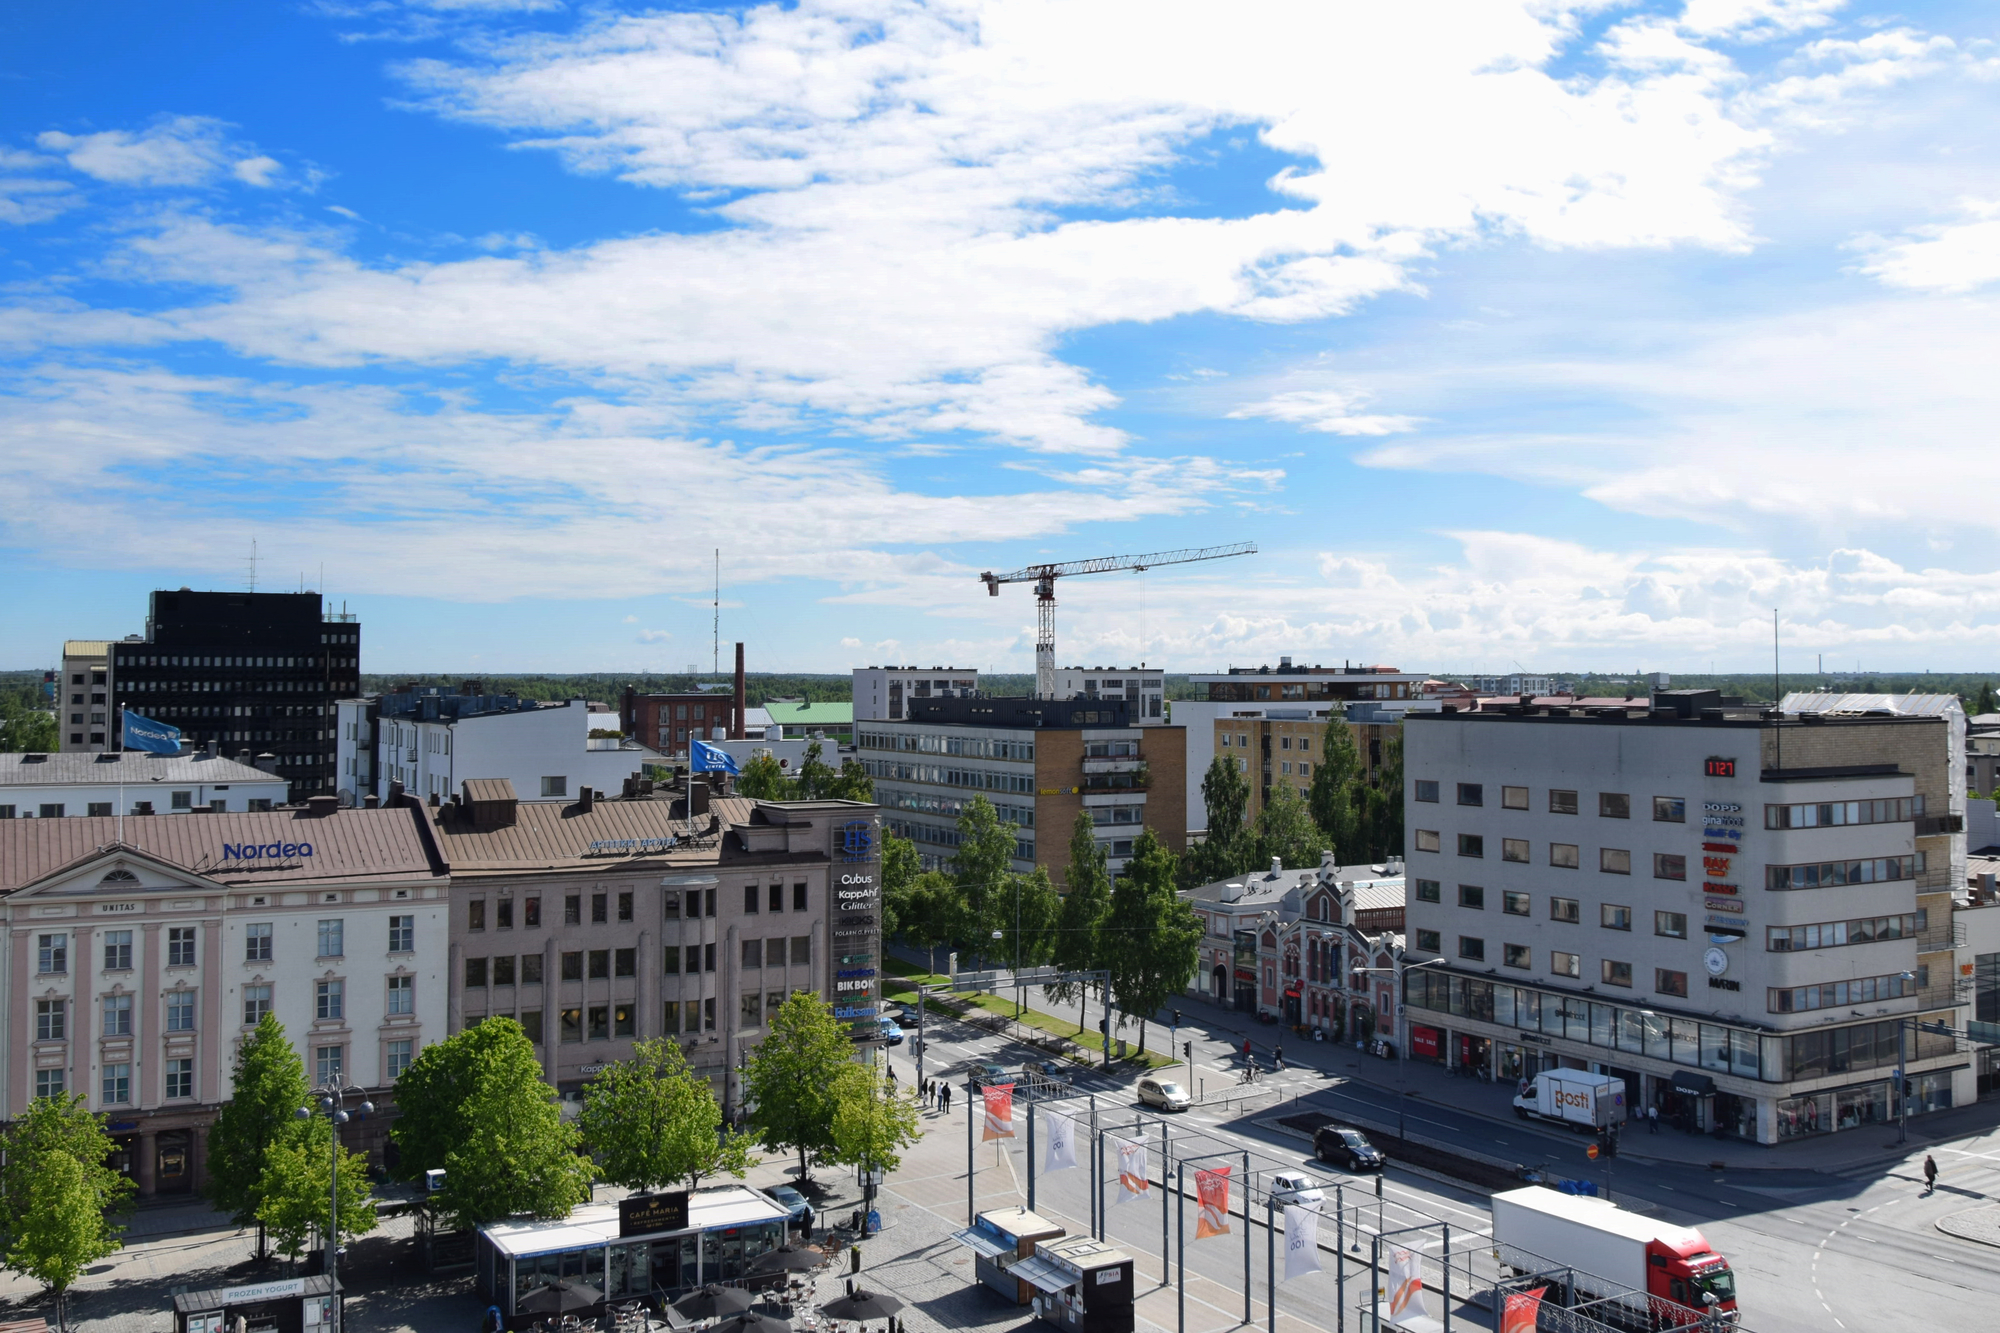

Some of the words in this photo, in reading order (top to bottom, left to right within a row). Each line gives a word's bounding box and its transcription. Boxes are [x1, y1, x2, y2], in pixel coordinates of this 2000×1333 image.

[130, 726, 167, 740] Nordea
[1040, 787, 1072, 795] lemonsoft
[1702, 803, 1739, 812] DOPP
[844, 830, 872, 848] HS
[223, 840, 313, 860] Nordea
[1703, 857, 1731, 870] RAX
[841, 873, 873, 885] Cubus
[838, 888, 878, 900] KappAhl
[1703, 882, 1736, 895] ROSSO
[102, 903, 136, 912] UNITAS
[840, 901, 873, 911] Glitter
[837, 981, 854, 992] BIK
[854, 980, 875, 990] BOK
[835, 1006, 877, 1019] Folksam
[1675, 1086, 1700, 1096] DOPP
[1555, 1090, 1589, 1109] posti
[629, 1208, 650, 1219] CAFÉ
[652, 1206, 679, 1216] MARIA
[228, 1288, 263, 1299] FROZEN
[265, 1283, 299, 1294] YOGURT
